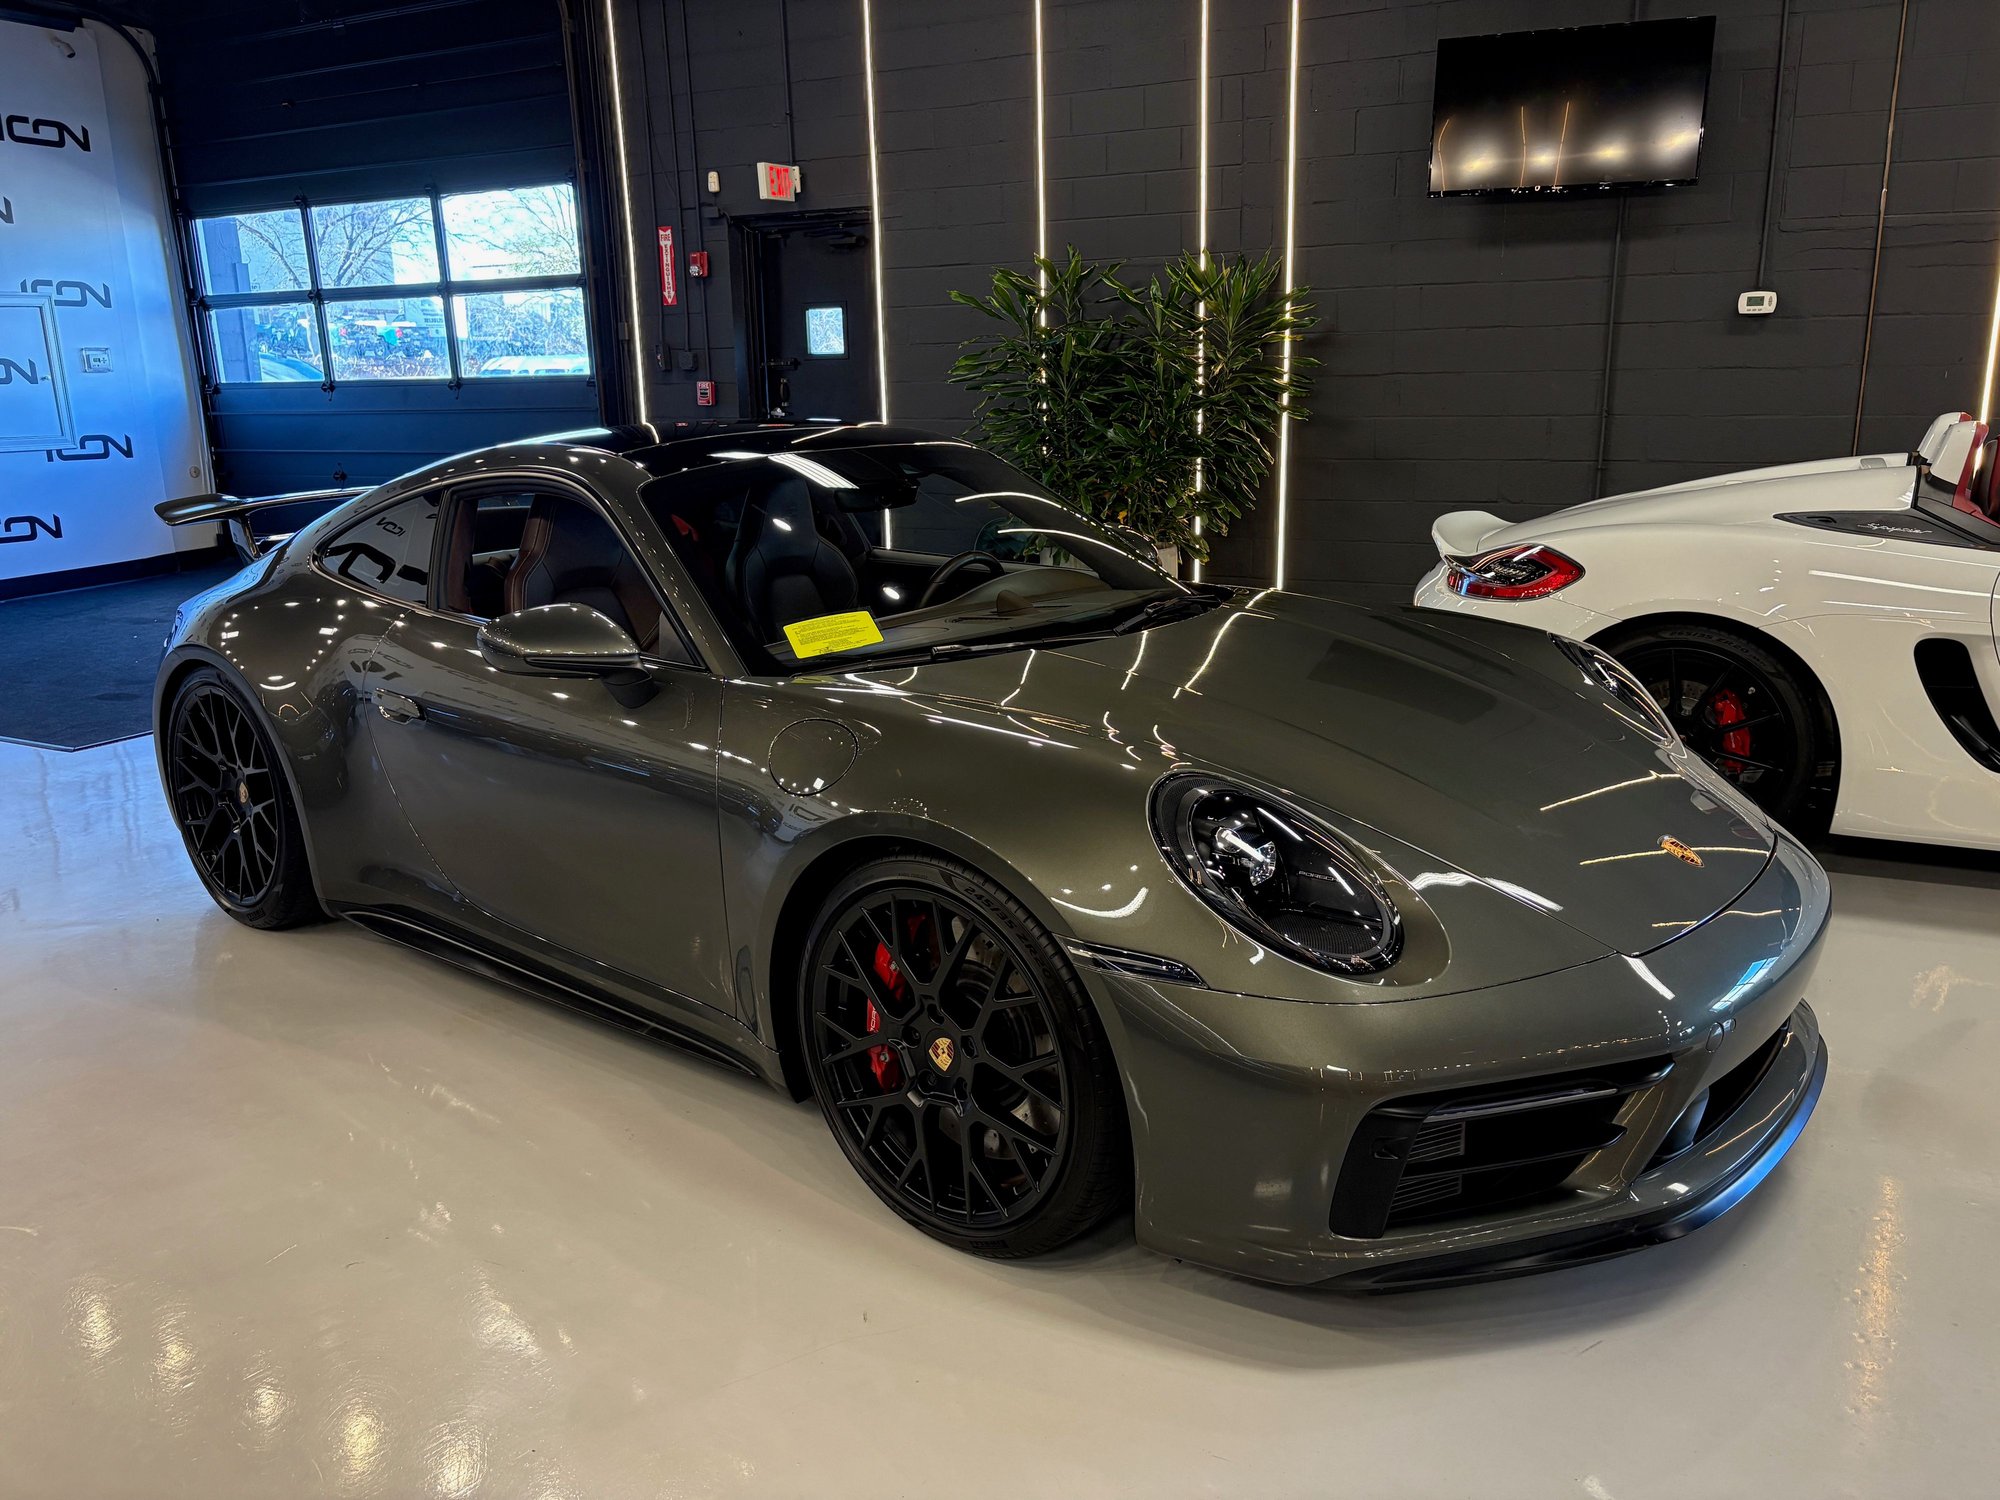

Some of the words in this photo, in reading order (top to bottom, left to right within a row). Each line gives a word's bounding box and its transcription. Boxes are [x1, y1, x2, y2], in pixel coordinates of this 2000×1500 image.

[768, 165, 790, 199] EXIT
[660, 233, 670, 242] FIRE
[664, 244, 673, 299] EXTINGUISHER
[1298, 870, 1337, 881] PORSCH
[964, 887, 1018, 929] 245/35
[1015, 933, 1053, 979] ZR20
